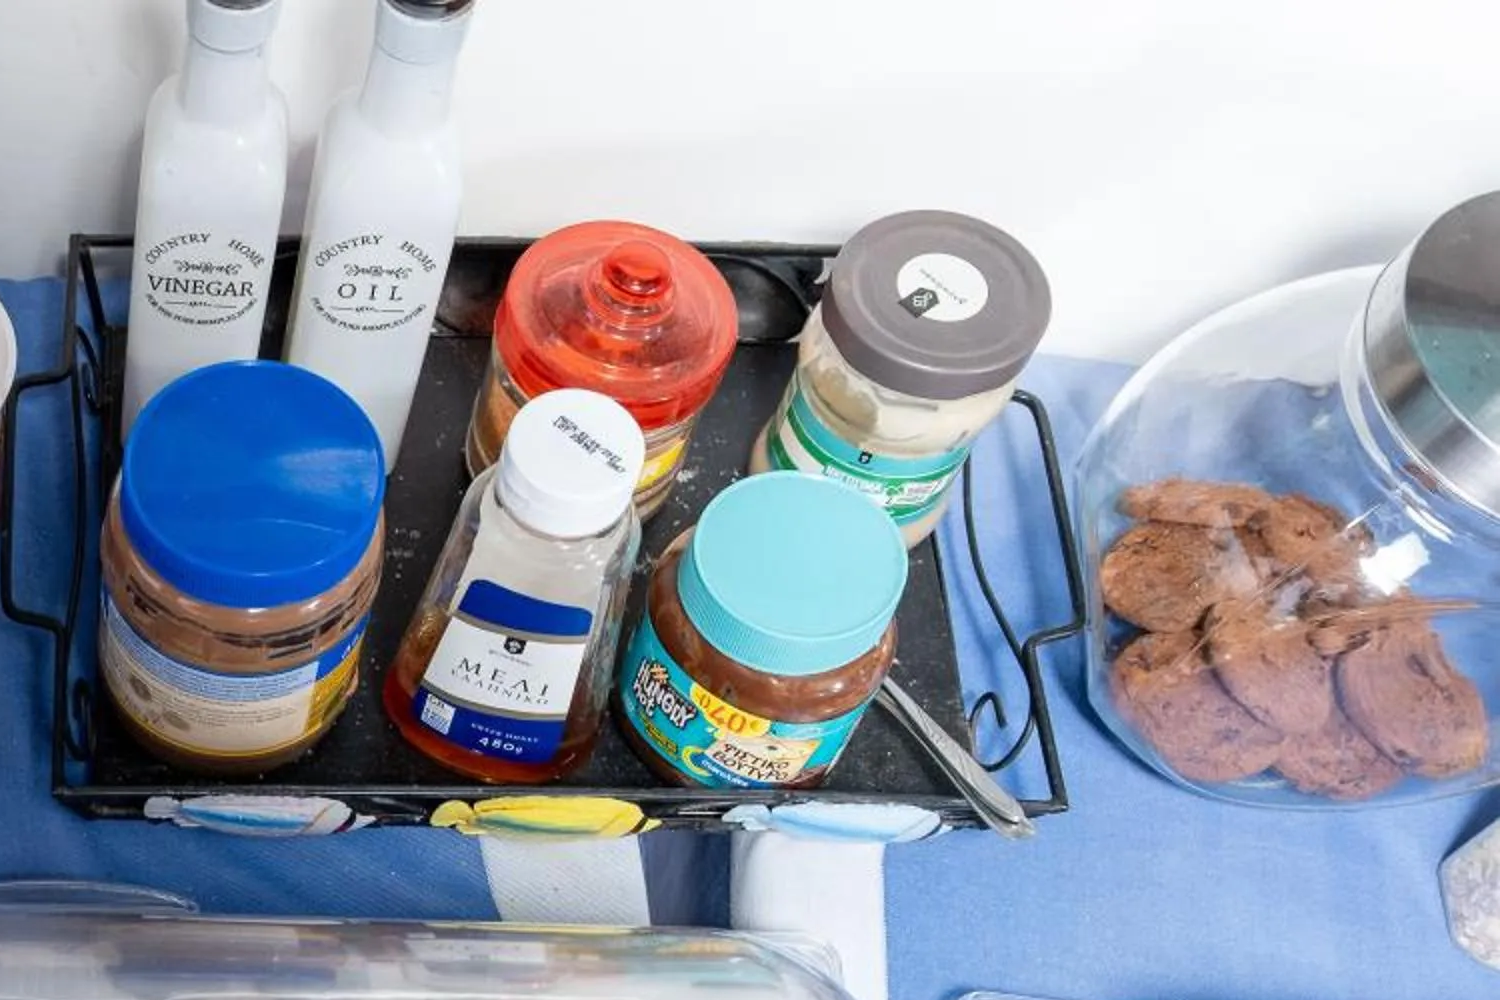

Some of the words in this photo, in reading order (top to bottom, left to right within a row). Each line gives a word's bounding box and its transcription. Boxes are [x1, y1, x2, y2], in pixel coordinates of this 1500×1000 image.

[145, 232, 211, 265] COUNTRY
[227, 239, 265, 269] HOME
[315, 235, 384, 267] COUNTRY
[399, 241, 437, 273] HOME
[147, 273, 255, 297] VINEGAR
[337, 282, 403, 301] OIL
